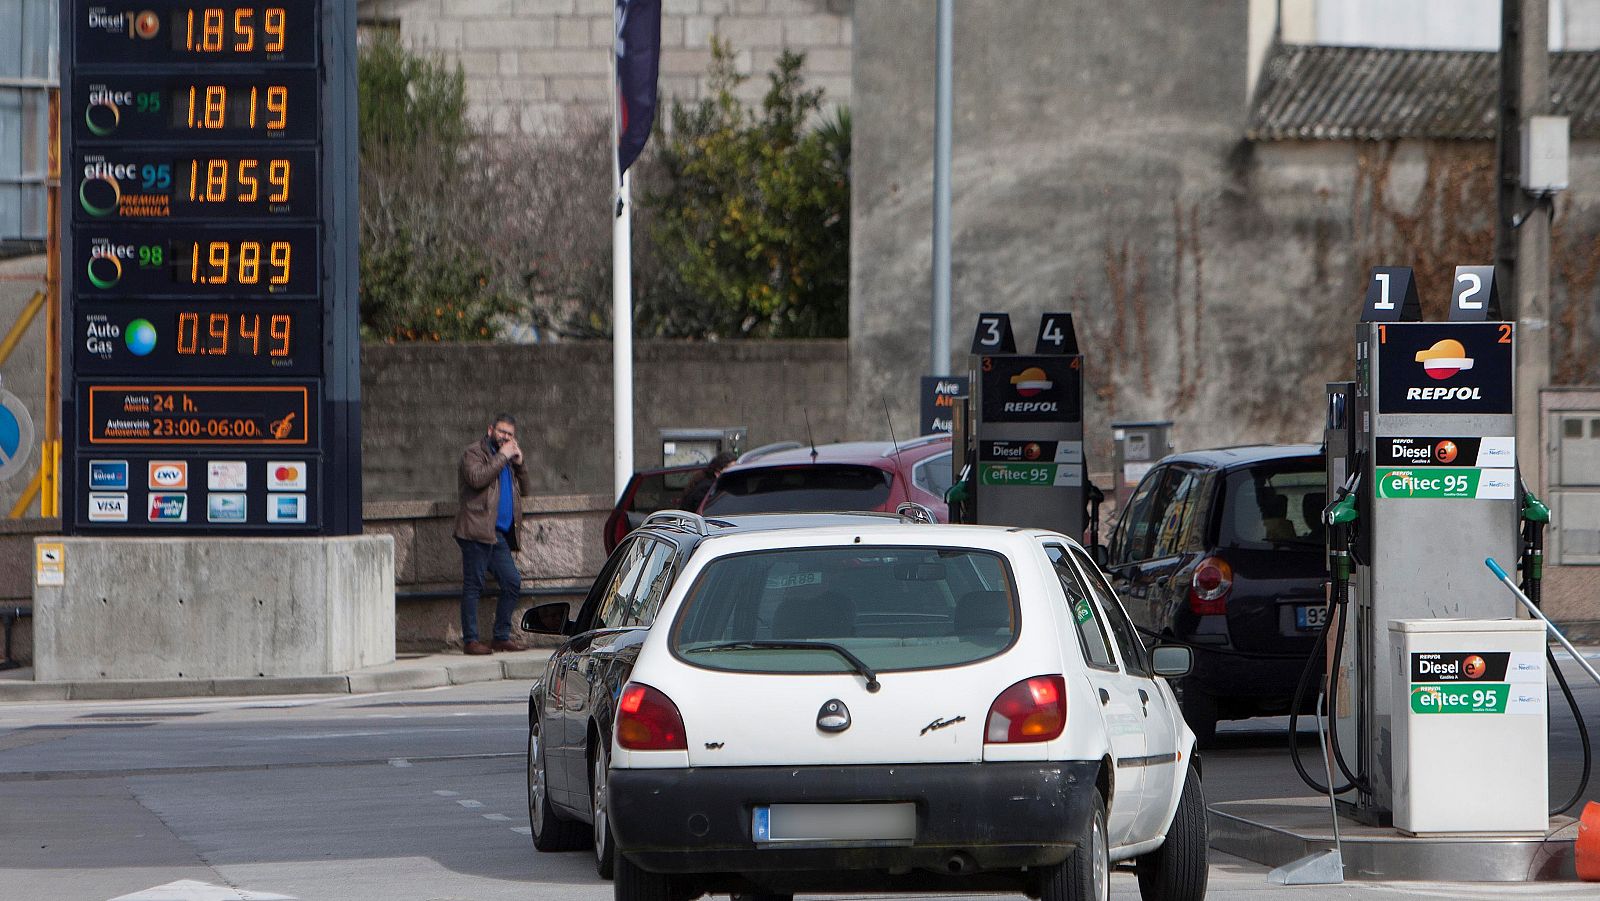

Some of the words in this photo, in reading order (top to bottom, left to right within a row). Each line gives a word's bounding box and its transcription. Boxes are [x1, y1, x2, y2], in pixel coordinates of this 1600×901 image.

[89, 12, 123, 28] Diesel
[186, 8, 286, 52] 1.859
[89, 89, 132, 106] efitec
[137, 92, 160, 112] 95
[188, 85, 288, 129] 1.819
[84, 162, 137, 180] efitec
[142, 164, 171, 189] 95
[189, 159, 291, 202] 1.859
[120, 194, 169, 206] PREMIUM
[119, 206, 170, 217] FORMULA
[91, 244, 135, 259] efitec
[139, 245, 163, 266] 98
[191, 241, 291, 284] 1.989
[1374, 273, 1395, 310] 1
[1456, 273, 1483, 310] 2
[87, 322, 120, 338] Auto
[177, 312, 291, 356] 0.949
[980, 318, 1000, 346] 3
[1042, 318, 1064, 346] 4
[1378, 325, 1387, 344] 1
[1498, 325, 1512, 344] 2
[87, 336, 113, 353] Gas
[982, 358, 992, 372] 3
[1070, 357, 1080, 370] 4
[935, 381, 960, 395] Aire
[1406, 387, 1482, 400] REPSOL
[153, 394, 174, 412] 24
[935, 394, 953, 407] Air
[1004, 402, 1058, 412] REPSOL
[932, 417, 953, 433] Aug
[993, 446, 1022, 456] Diesel
[1392, 445, 1431, 458] Diesel
[992, 468, 1027, 480] efitec
[1030, 468, 1048, 481] 95
[1392, 476, 1441, 490] efitec
[1444, 475, 1468, 492] 95
[97, 501, 122, 512] VISA
[1419, 660, 1459, 674] Diesel
[1420, 692, 1469, 706] efitec
[1472, 690, 1497, 708] 95
